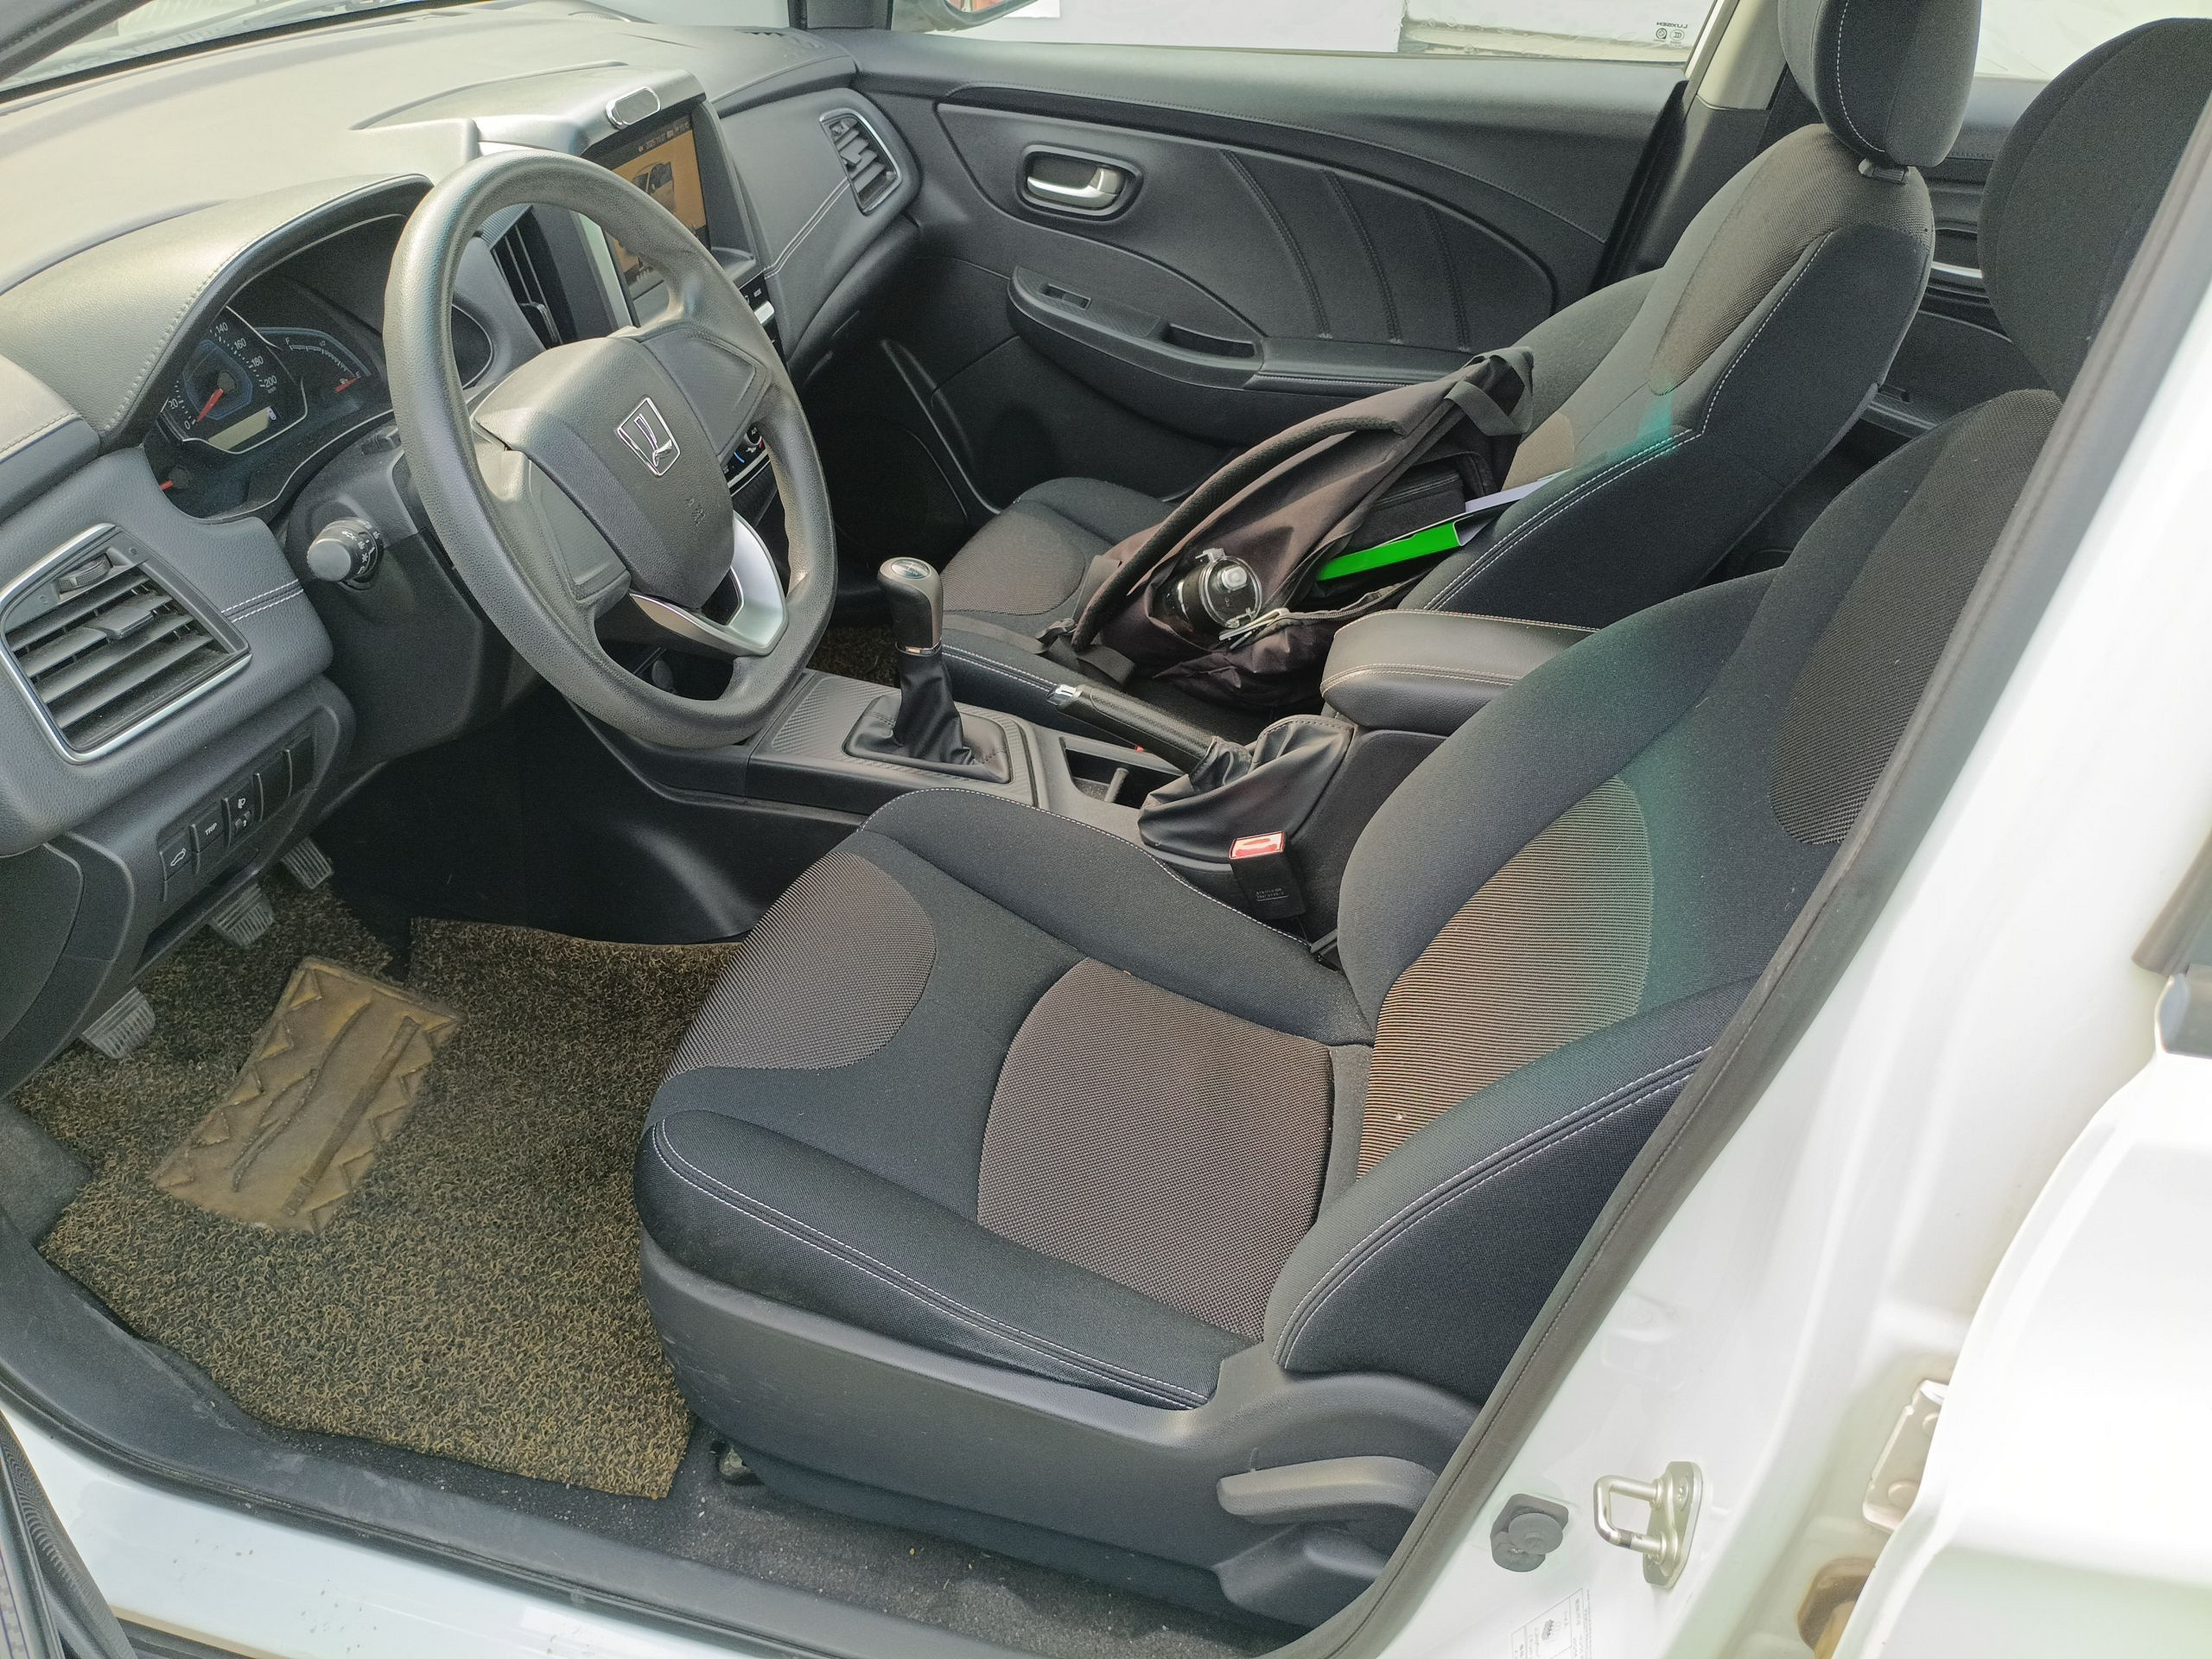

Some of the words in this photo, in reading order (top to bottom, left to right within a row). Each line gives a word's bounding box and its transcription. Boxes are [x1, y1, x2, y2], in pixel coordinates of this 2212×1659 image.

[216, 322, 229, 334] 140
[234, 338, 247, 350] 160
[251, 355, 264, 368] 180
[264, 375, 277, 388] 200
[184, 420, 191, 430] 0
